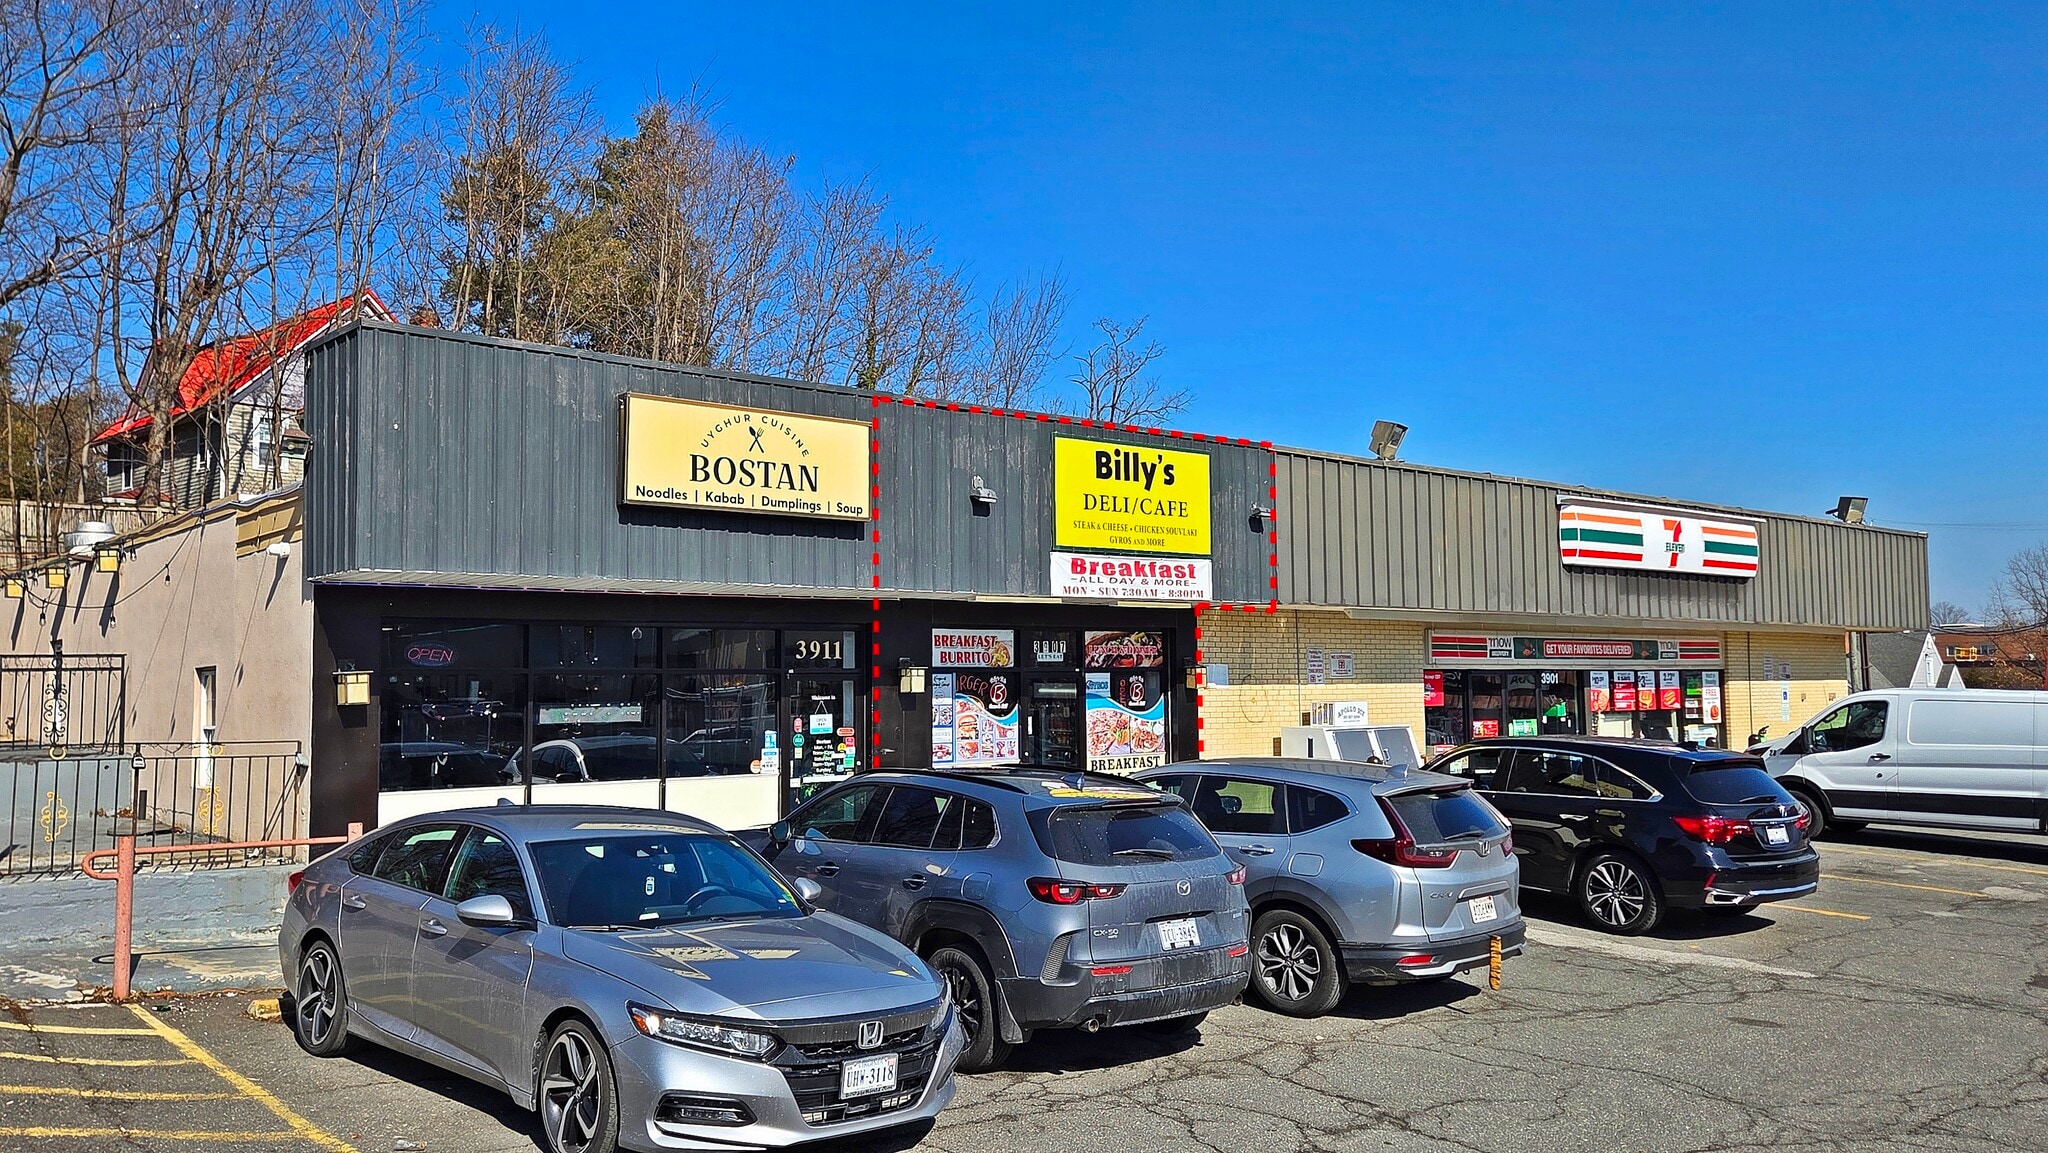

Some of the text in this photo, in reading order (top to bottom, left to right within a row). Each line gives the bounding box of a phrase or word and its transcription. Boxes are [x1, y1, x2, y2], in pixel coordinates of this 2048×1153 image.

[701, 414, 809, 458] UYGHUR CUISINE
[690, 454, 819, 493] BOSTAN
[1095, 448, 1175, 492] Billy's
[635, 485, 863, 516] Noodles Kabab Dumplings Soup
[1083, 493, 1189, 518] DELI/CAFE
[1073, 520, 1096, 530] STEAK
[1102, 522, 1128, 532] CHEESE
[1134, 524, 1165, 535] CHICKEN
[1166, 526, 1198, 537] SOUVLAKI
[1109, 535, 1165, 547] GYROS AND MORE
[1070, 557, 1197, 579] Breakfast
[1109, 577, 1136, 585] DAY
[1140, 578, 1150, 586] &
[1062, 585, 1088, 595] MON
[1098, 586, 1119, 596] SUN
[1121, 588, 1158, 598] 7:30AM
[1168, 589, 1204, 599] 8:30PM
[933, 634, 998, 648] BREAKFAST
[1033, 640, 1066, 653] 3907
[407, 647, 454, 662] OPEN
[795, 640, 842, 660] 3911
[1546, 644, 1631, 655] GET YOUR FAVORITES DELIVERED
[940, 651, 991, 664] BURRITO
[1540, 672, 1559, 684] 3901
[1090, 756, 1161, 771] BREAKFAST
[1093, 928, 1119, 937] CX-50
